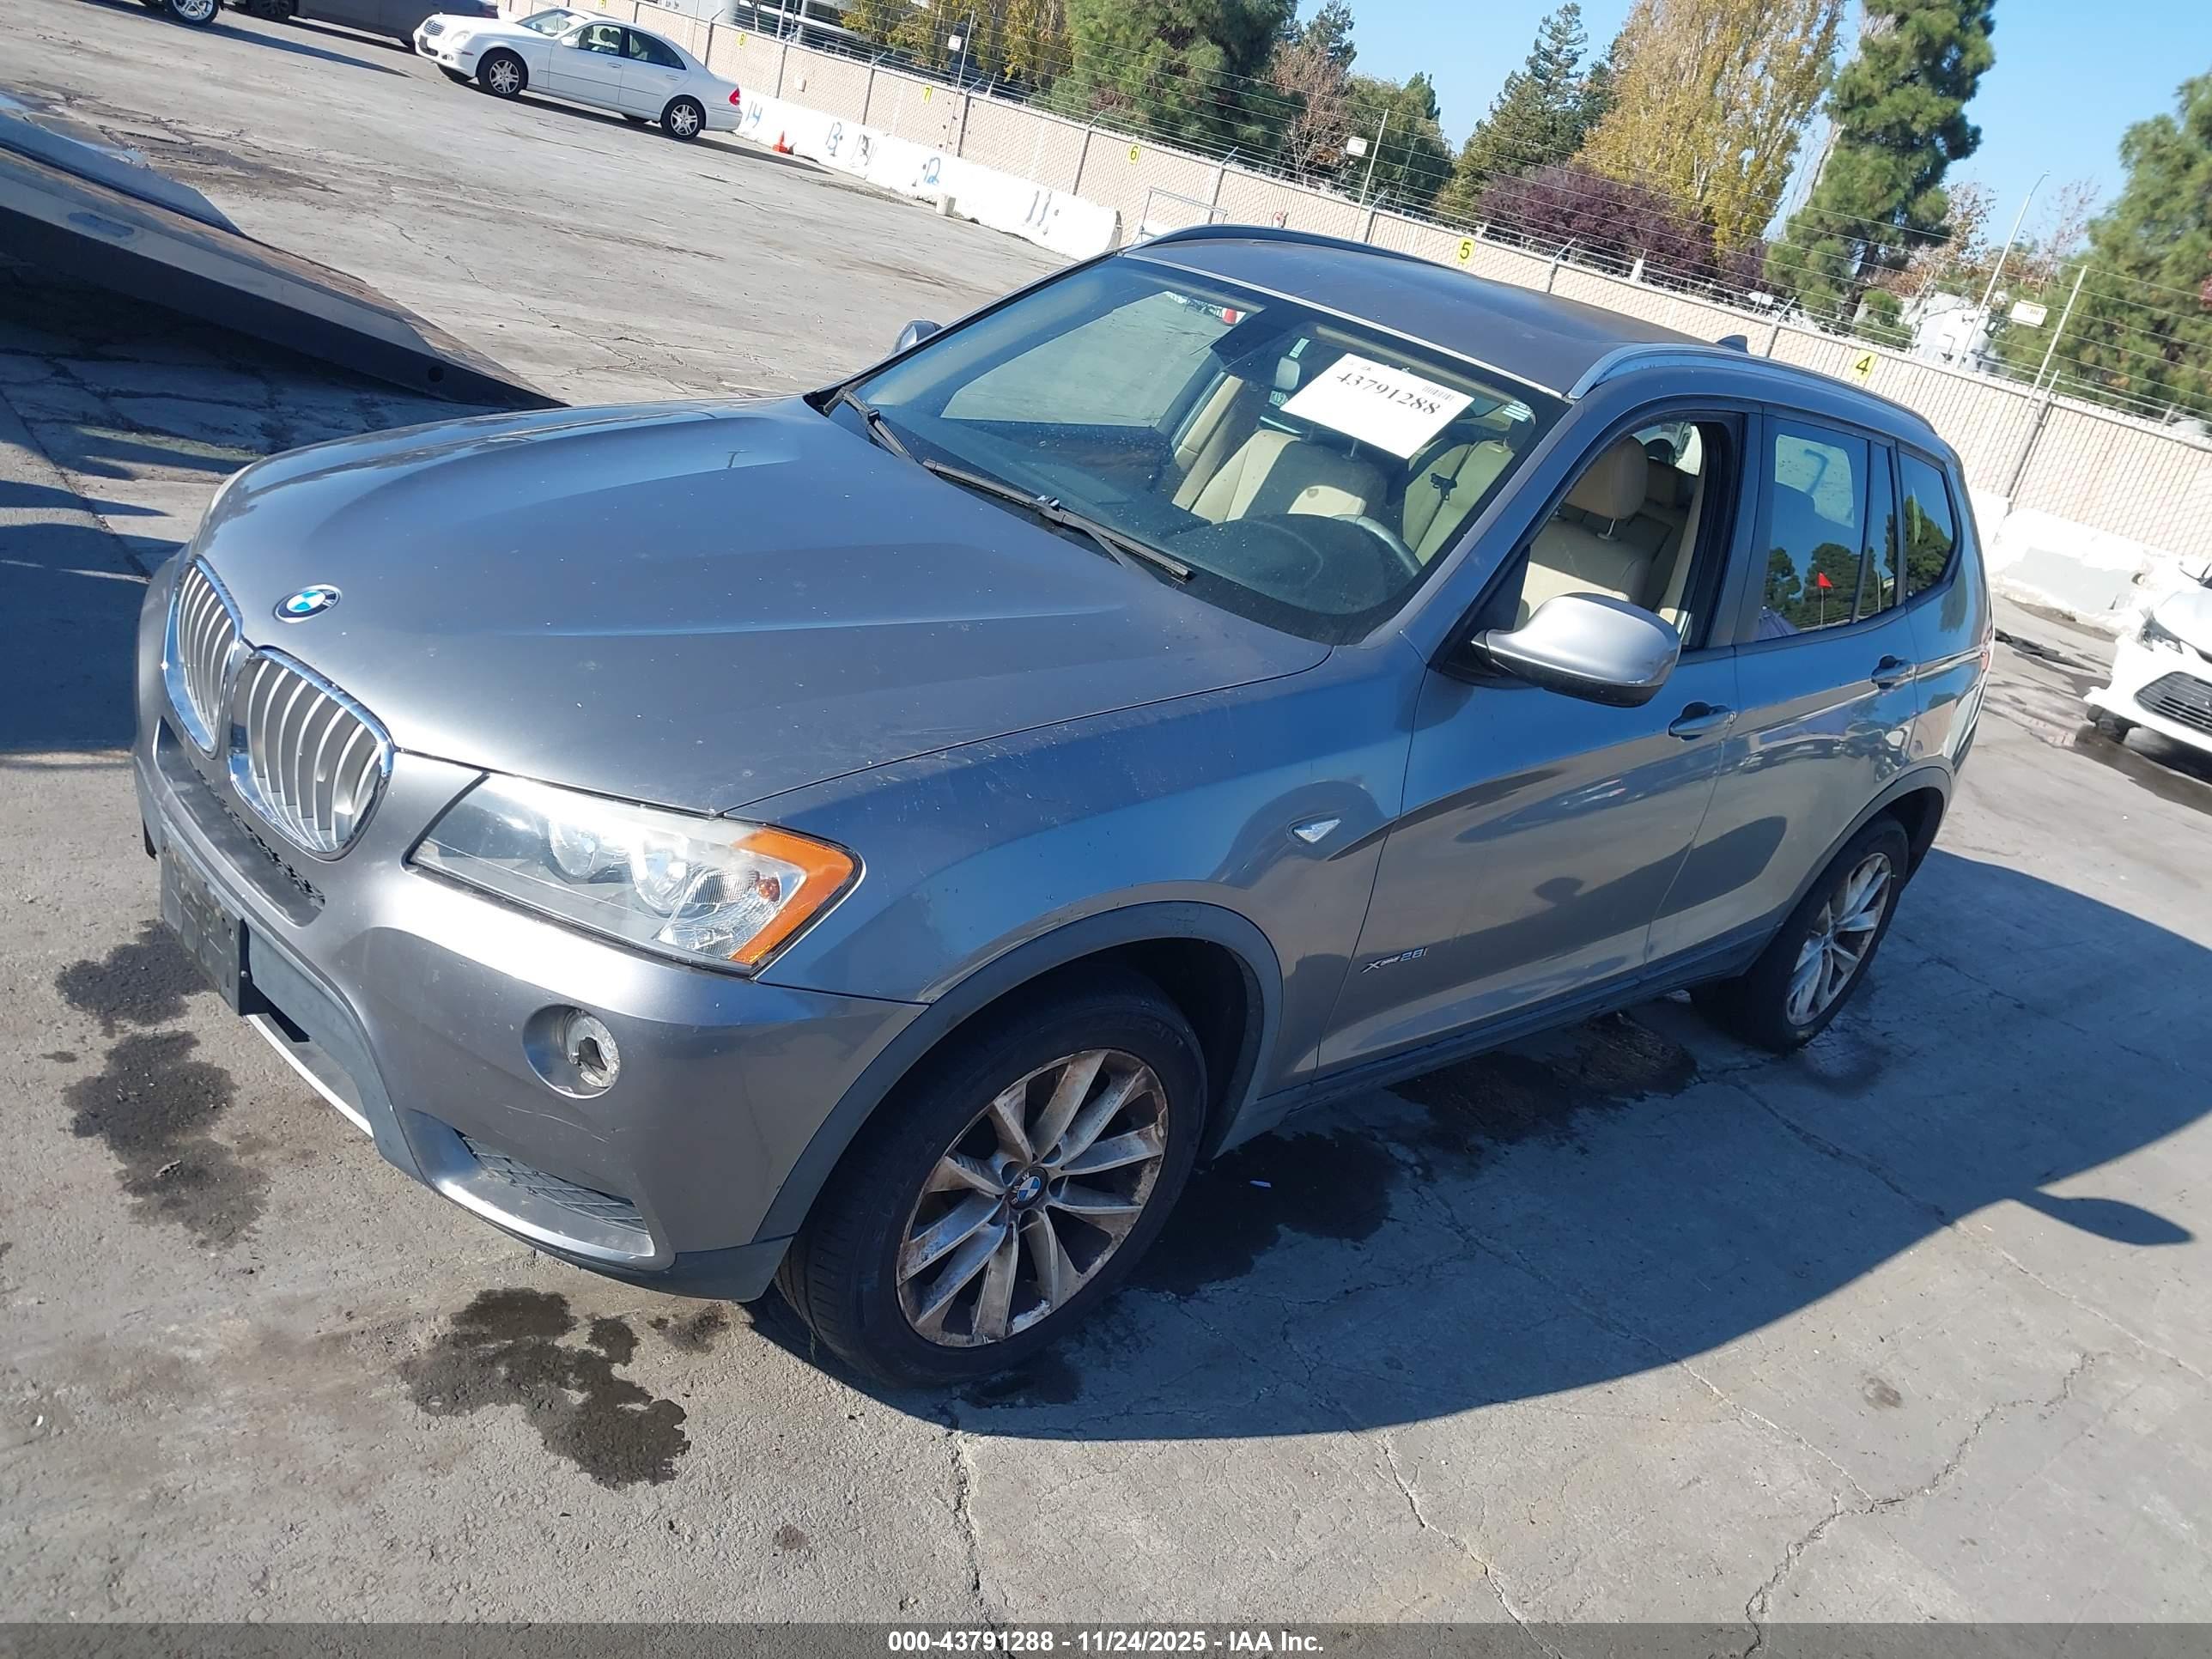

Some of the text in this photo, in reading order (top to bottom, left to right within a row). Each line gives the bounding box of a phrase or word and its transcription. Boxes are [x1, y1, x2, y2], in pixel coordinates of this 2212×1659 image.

[924, 87, 931, 101] 7
[745, 100, 763, 129] 14
[1130, 145, 1139, 161] 6
[923, 156, 941, 185] 12
[1024, 189, 1053, 228] 11
[1460, 241, 1472, 259] 5
[1855, 355, 1872, 376] 4
[1336, 372, 1441, 415] 43791288
